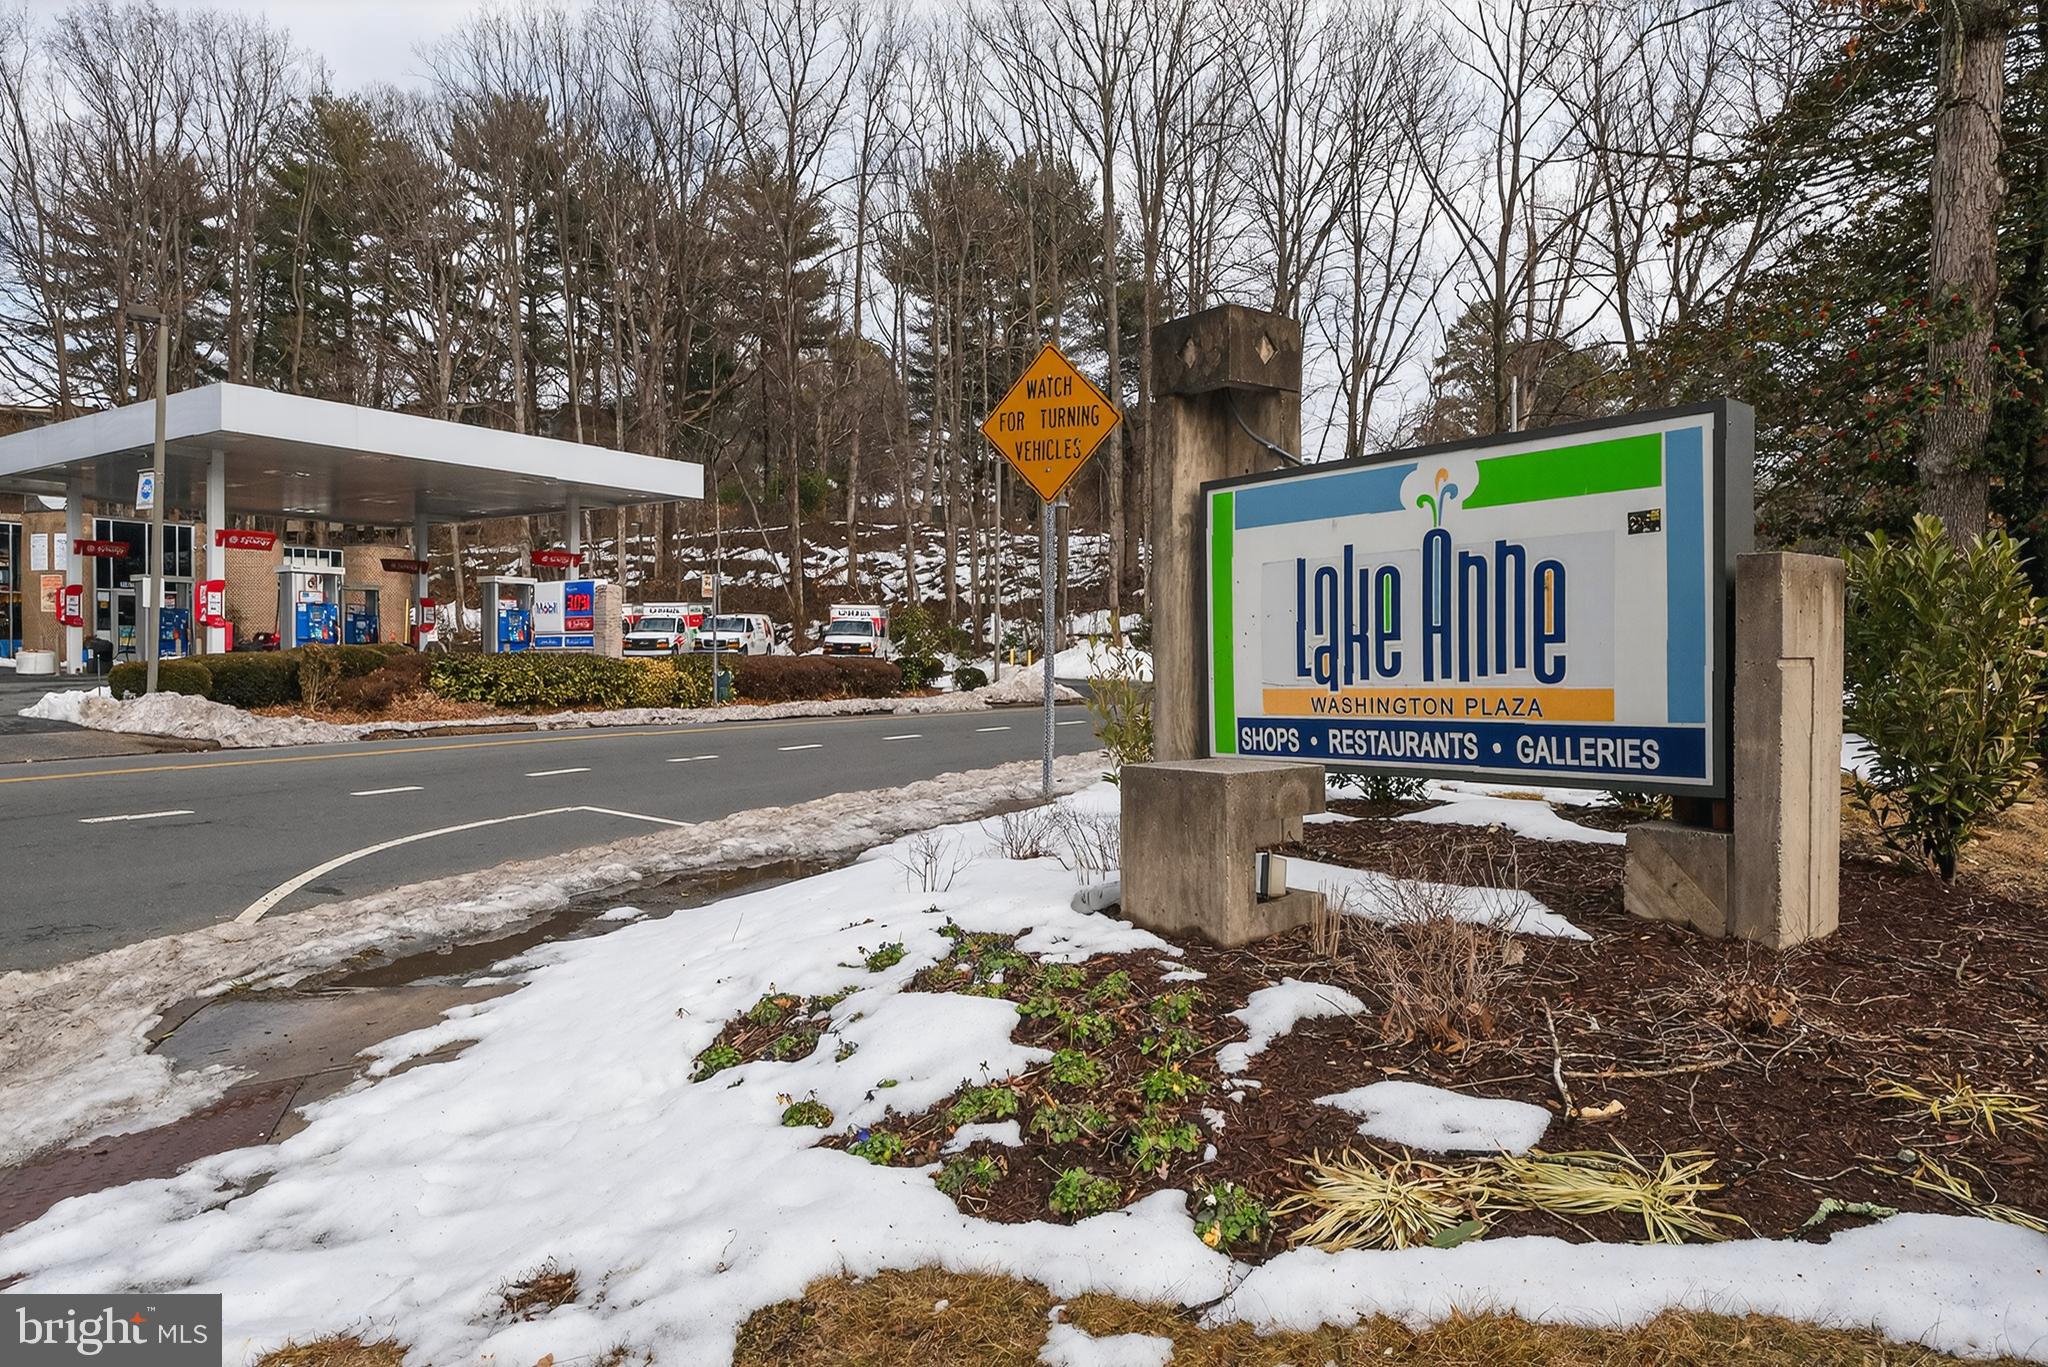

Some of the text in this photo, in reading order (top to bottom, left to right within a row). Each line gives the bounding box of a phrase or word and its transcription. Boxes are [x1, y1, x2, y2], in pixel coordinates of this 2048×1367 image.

[1027, 376, 1072, 399] WATCH
[1000, 405, 1100, 432] FOR TURNING
[1015, 438, 1081, 461] VEHICLES
[1297, 528, 1566, 692] Lake Anne
[1311, 697, 1543, 717] WASHINGTON PLAZA
[1241, 727, 1661, 770] SHOPS RESTAURANTS GALLERIES
